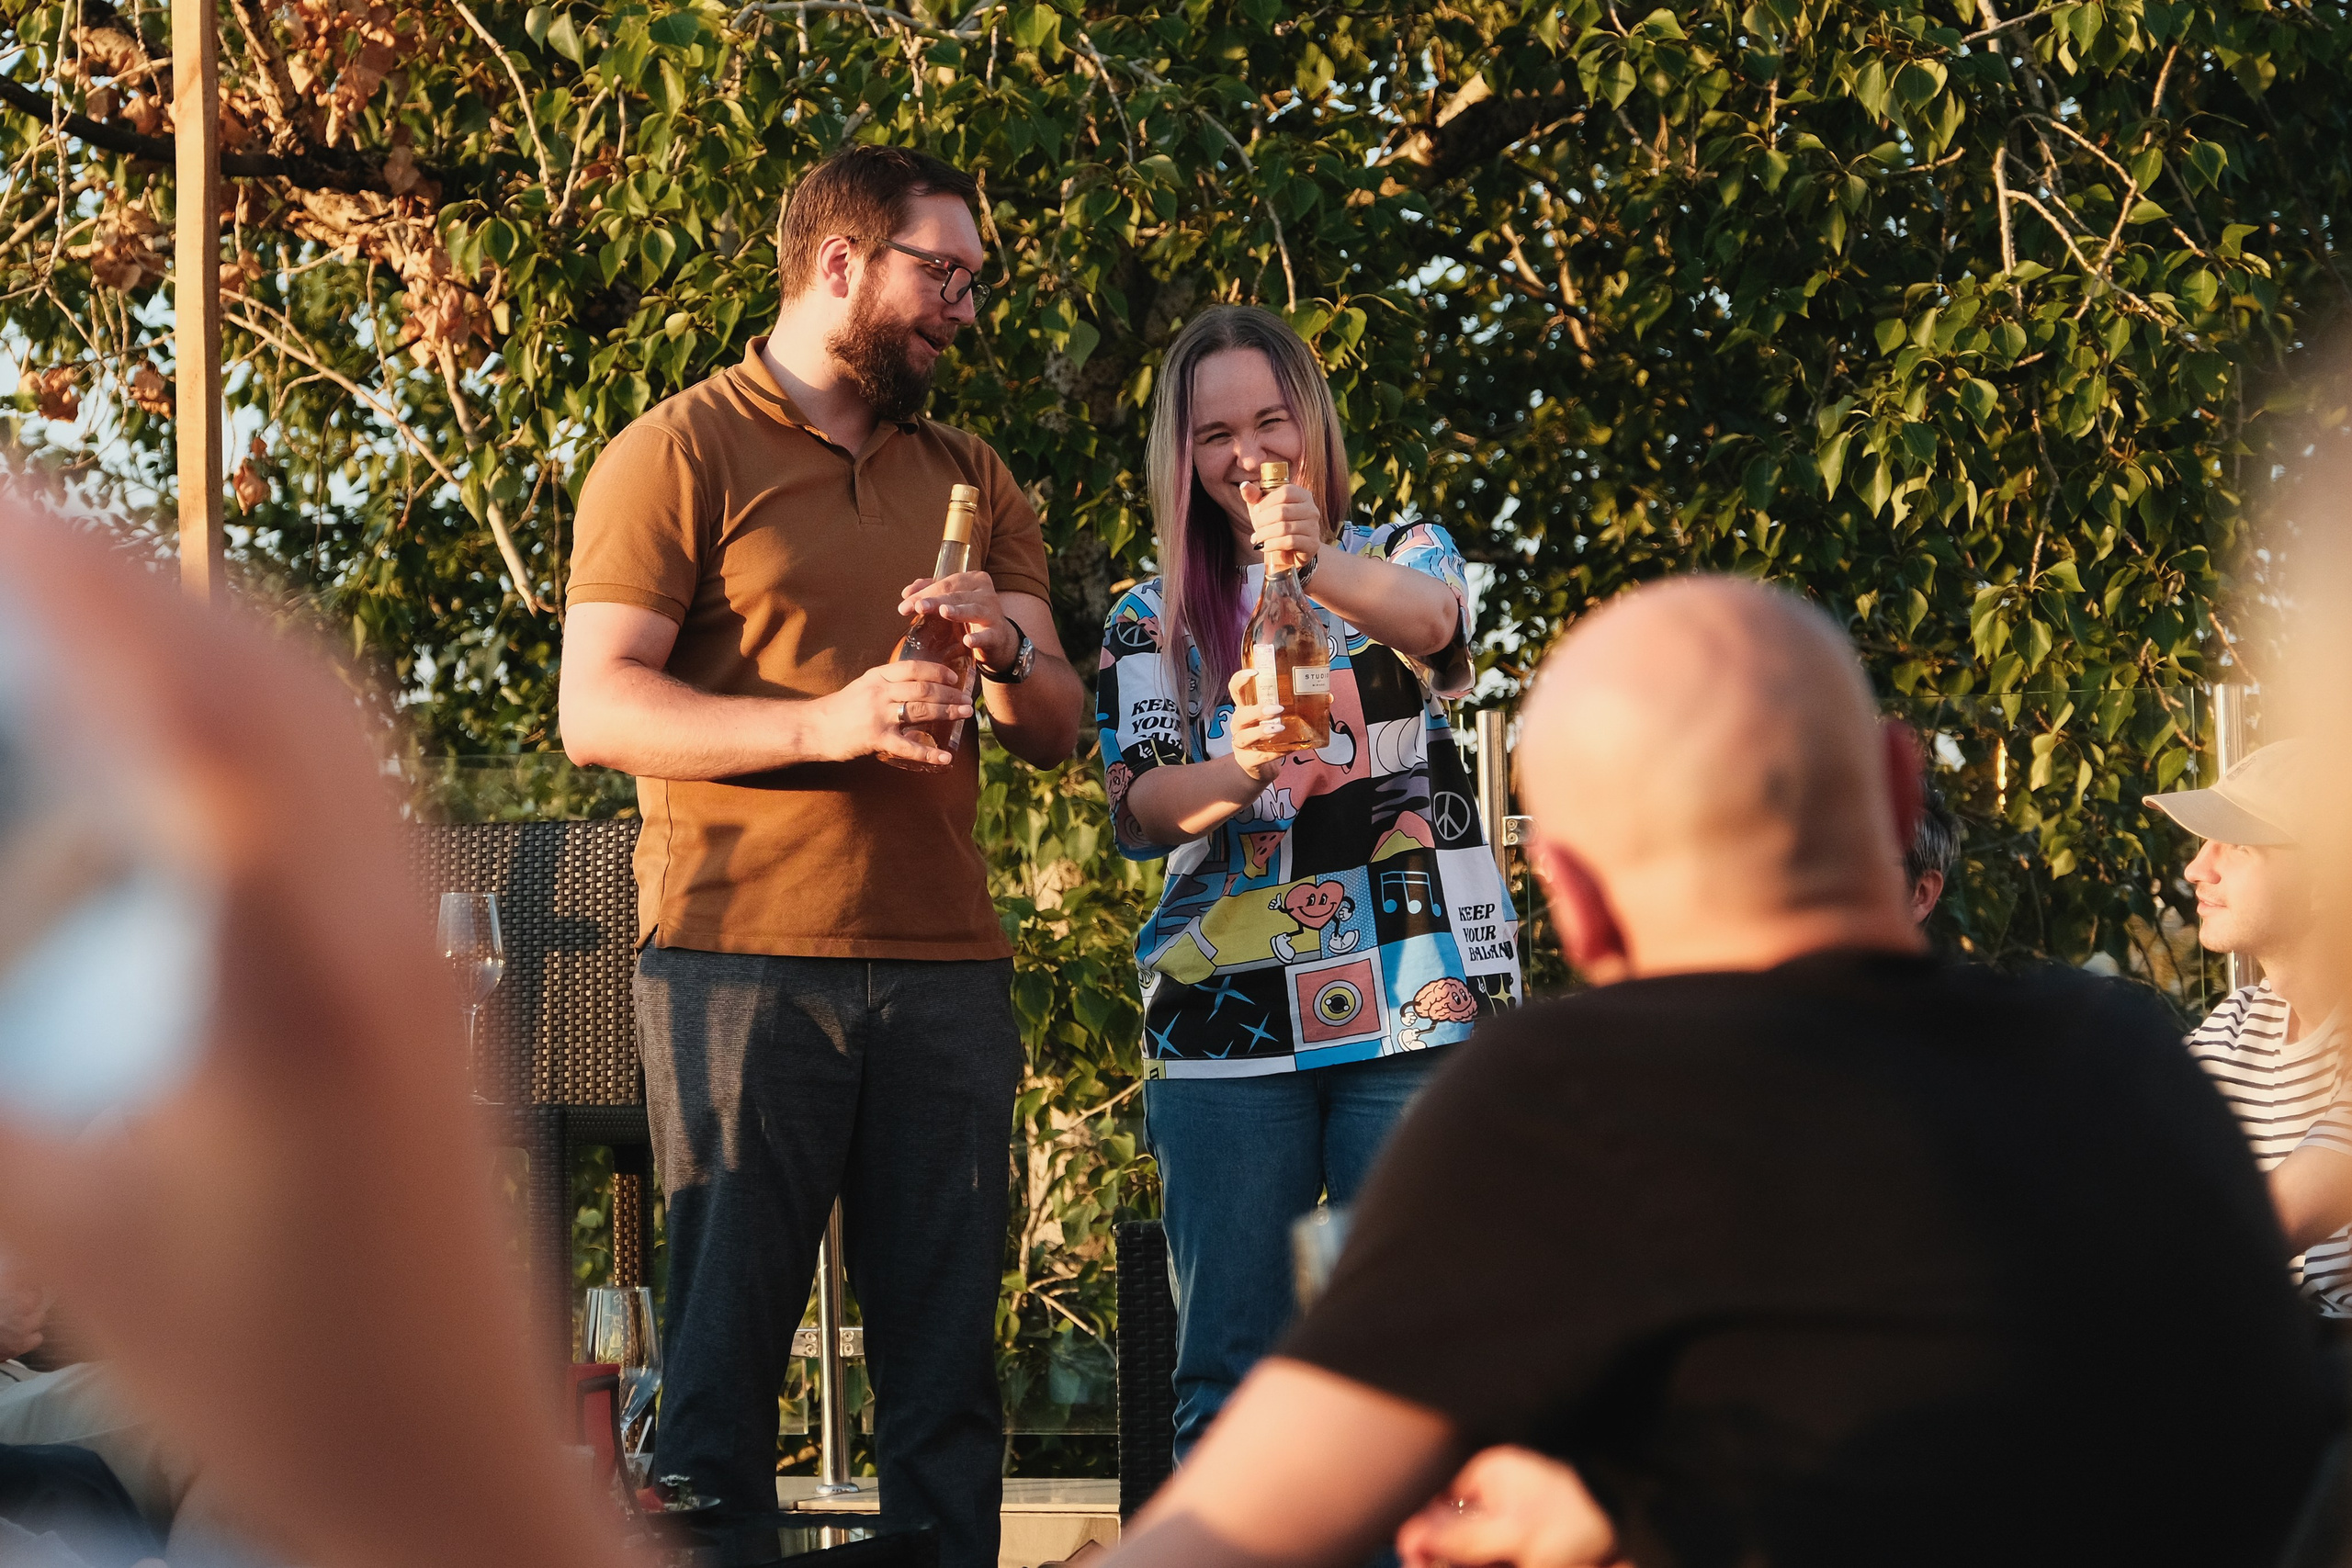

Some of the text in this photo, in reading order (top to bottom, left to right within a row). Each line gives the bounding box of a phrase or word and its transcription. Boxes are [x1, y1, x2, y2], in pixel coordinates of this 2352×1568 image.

[1131, 698, 1180, 716] KEE
[1458, 903, 1496, 921] KEEP
[1463, 925, 1497, 942] YOUR
